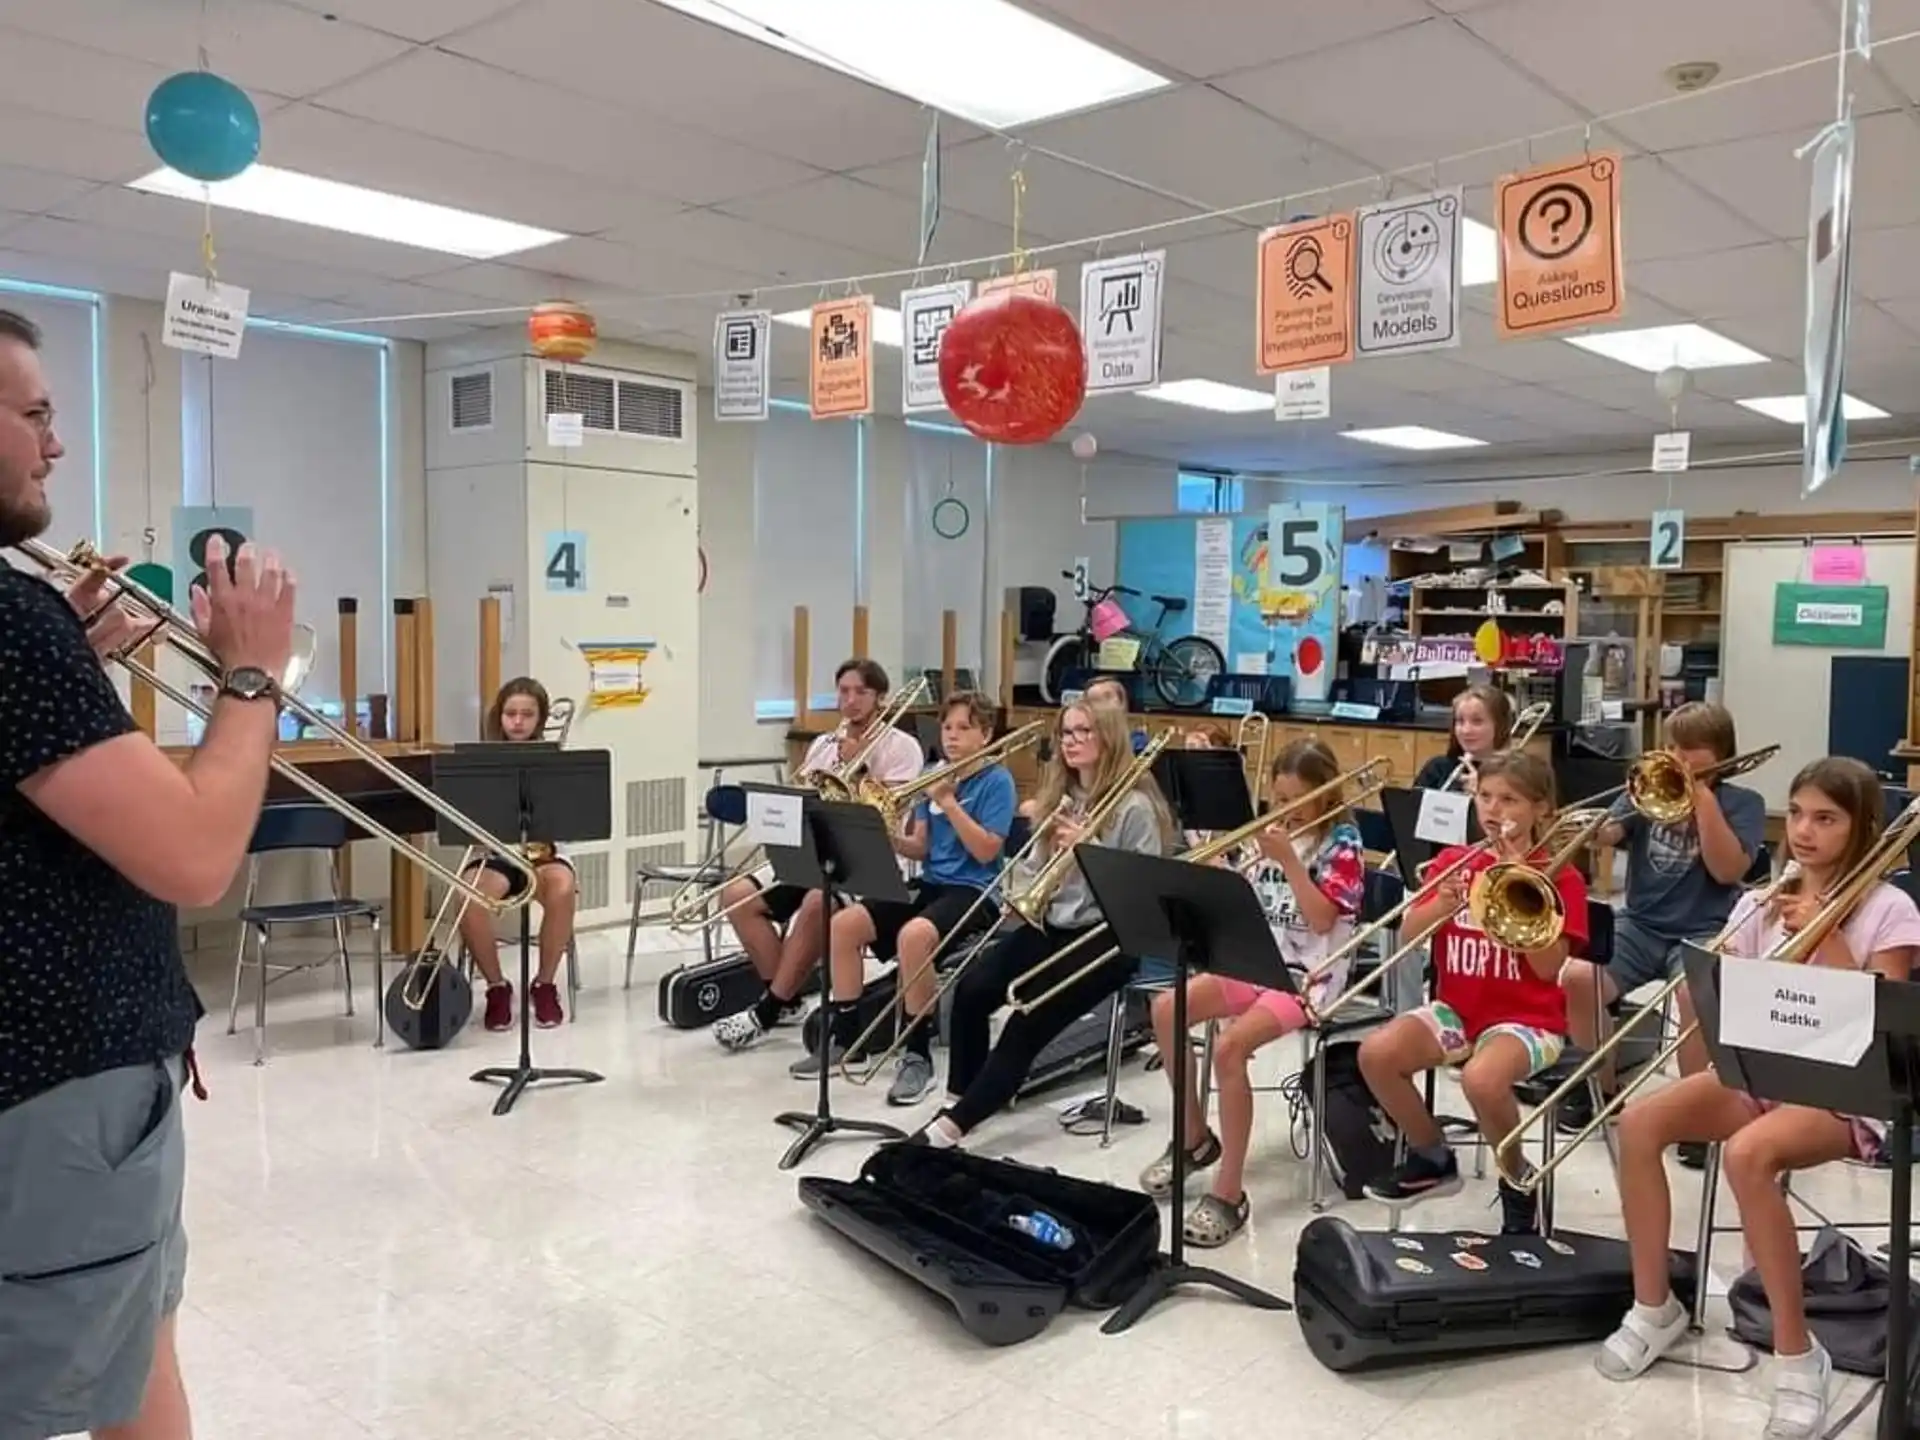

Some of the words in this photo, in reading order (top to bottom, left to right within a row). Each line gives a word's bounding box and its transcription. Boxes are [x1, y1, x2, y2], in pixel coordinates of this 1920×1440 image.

[1537, 270, 1579, 285] Asking
[1513, 280, 1606, 311] Questions
[1373, 315, 1438, 340] Models
[1266, 332, 1343, 353] Investigations
[1102, 361, 1134, 379] Data
[1280, 520, 1322, 587] 5
[1657, 521, 1681, 565] 2
[546, 542, 581, 588] 4
[1074, 564, 1086, 598] 3
[1774, 988, 1816, 1006] Alana
[1770, 1009, 1821, 1029] Radtke
